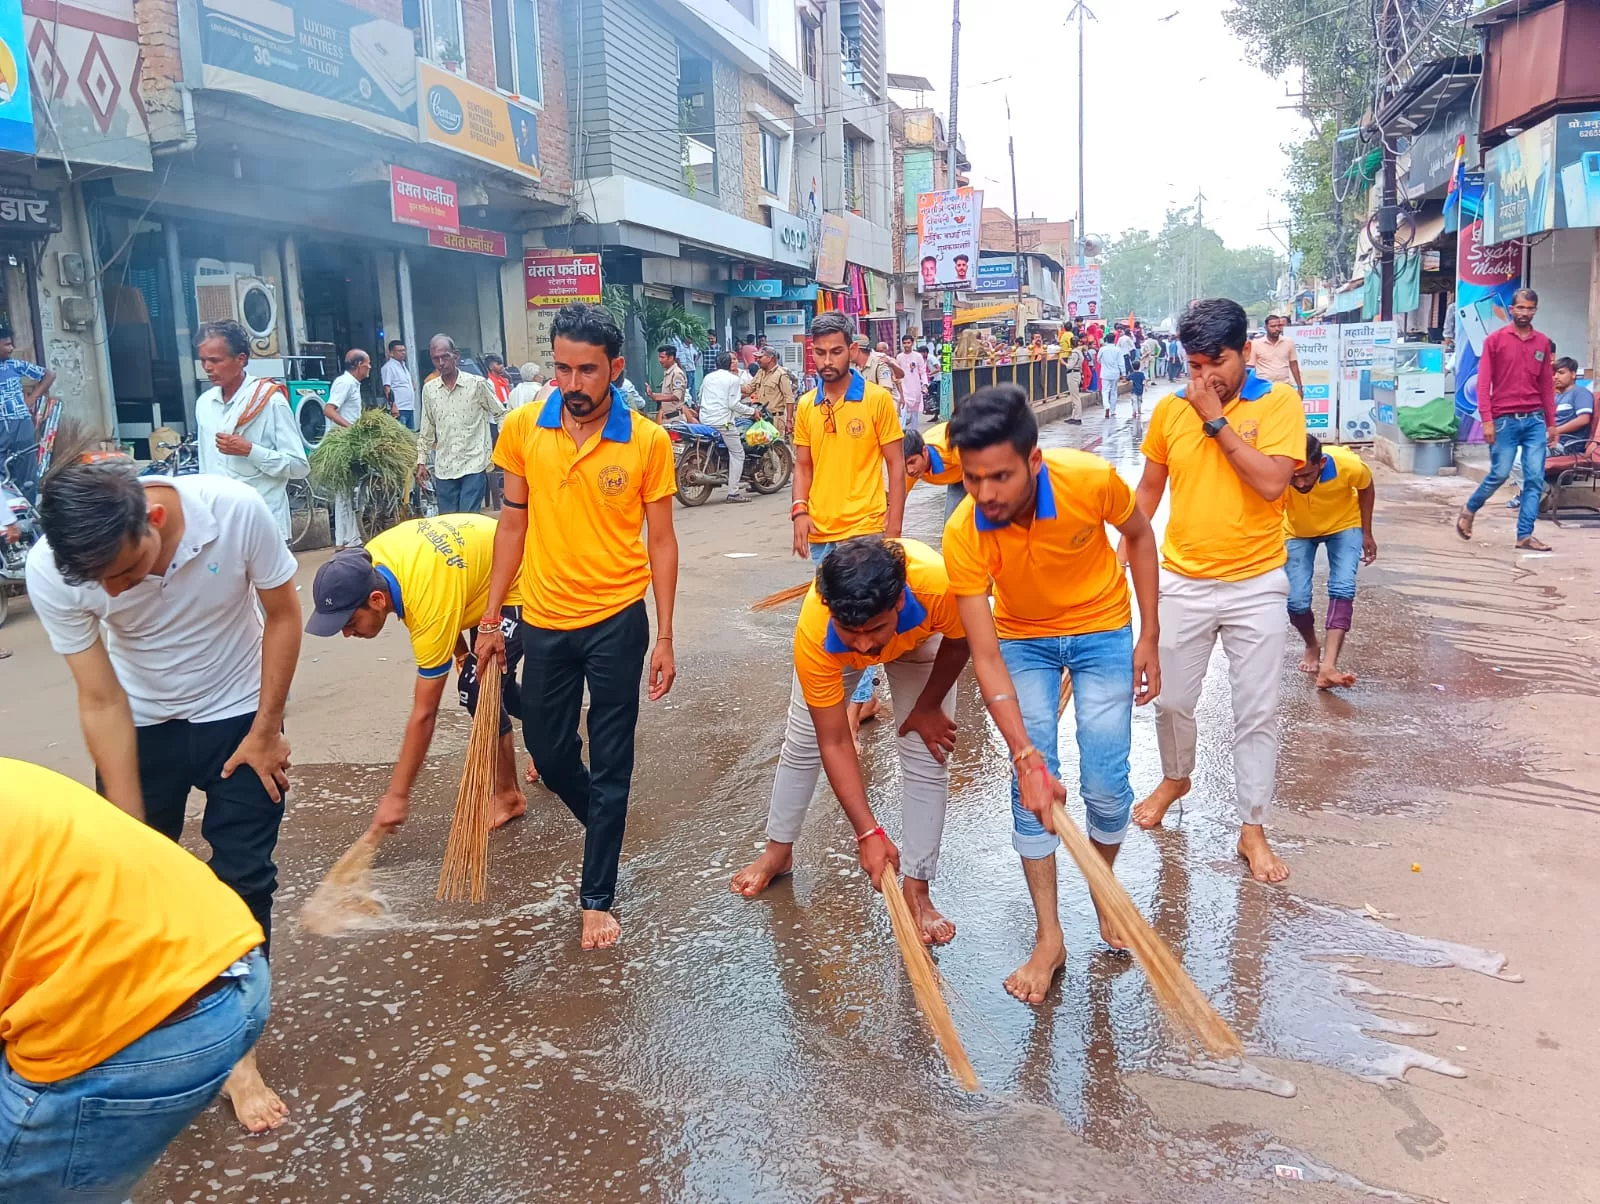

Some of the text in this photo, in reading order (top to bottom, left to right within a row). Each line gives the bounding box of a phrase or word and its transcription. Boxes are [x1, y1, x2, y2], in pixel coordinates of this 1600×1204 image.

[303, 17, 336, 40] LUXURY
[300, 32, 343, 59] MATTRESS
[308, 57, 339, 79] PILLOW
[557, 258, 596, 276] फर्नीचर
[738, 281, 774, 293] vivo
[1344, 325, 1374, 338] महावीर
